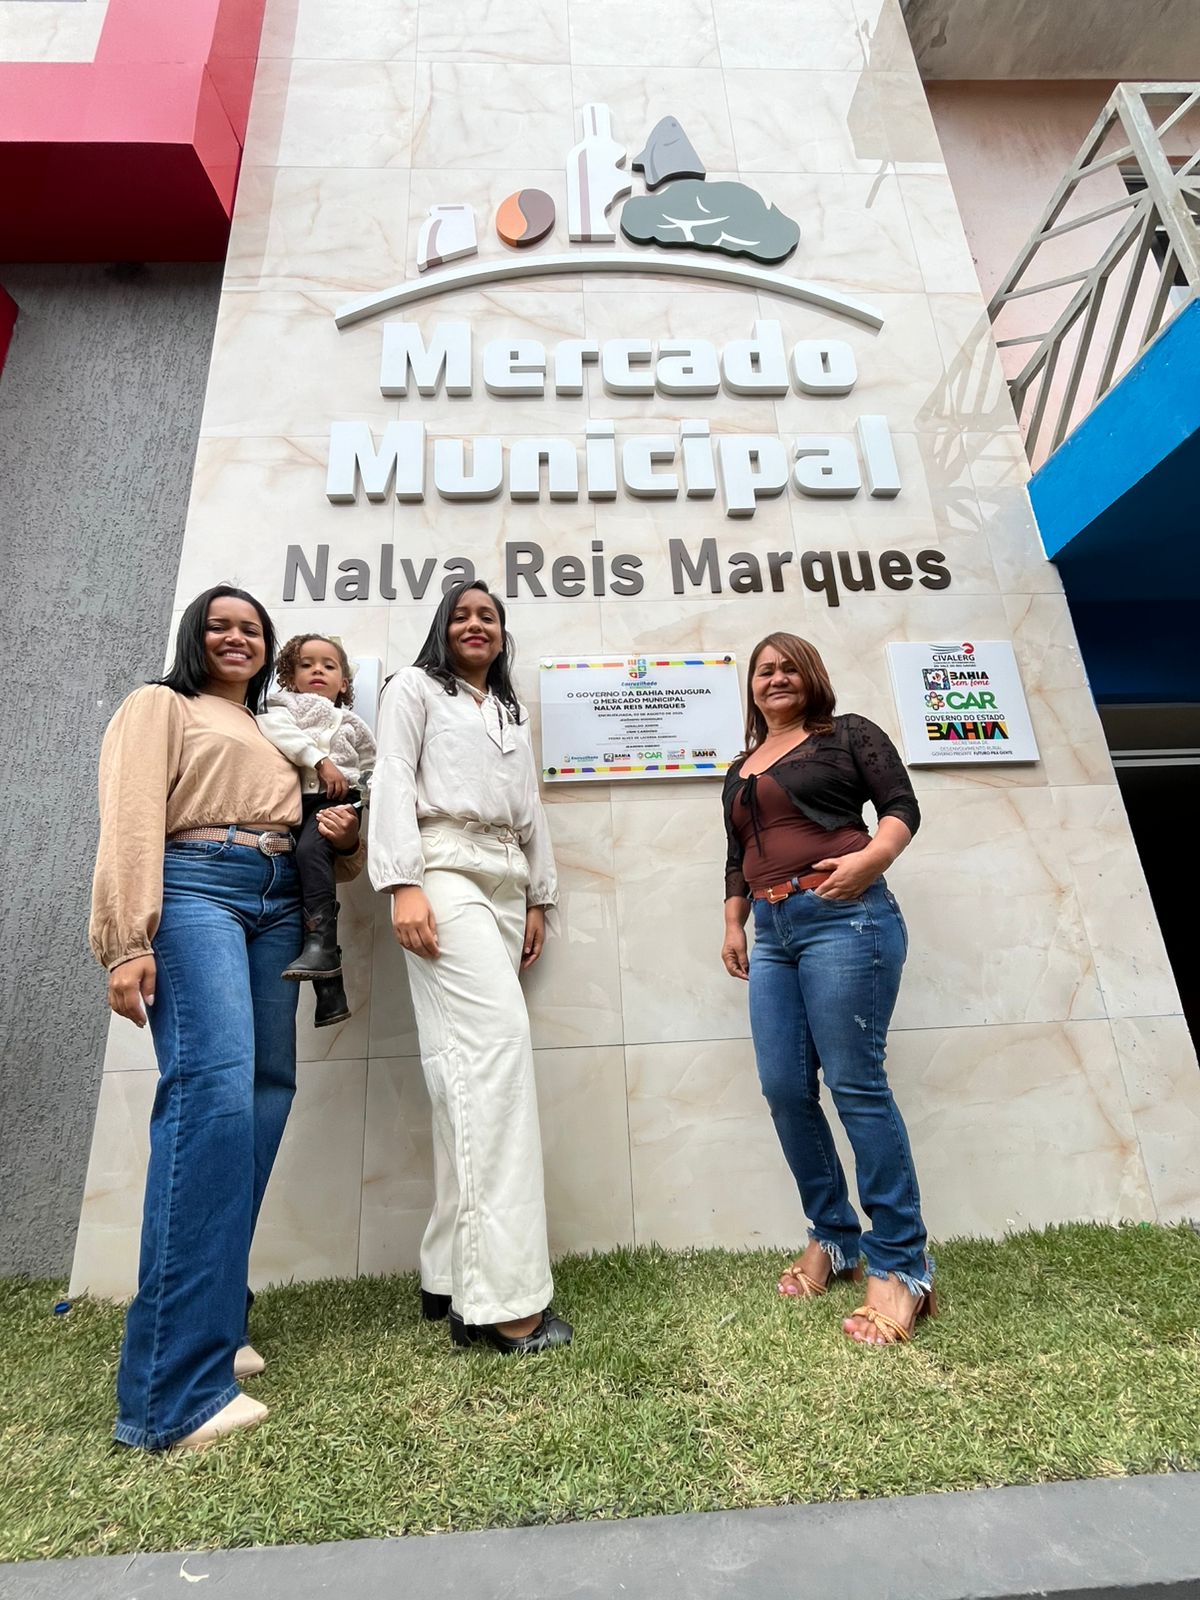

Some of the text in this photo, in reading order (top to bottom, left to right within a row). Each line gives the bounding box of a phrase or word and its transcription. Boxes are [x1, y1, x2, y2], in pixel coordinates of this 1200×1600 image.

[380, 319, 858, 397] Mercado
[326, 415, 901, 517] Municipal
[505, 540, 644, 597] Reis
[669, 538, 951, 607] Marques
[932, 654, 975, 662] CIVALERG
[949, 671, 989, 680] BAHIA
[970, 679, 990, 687] fome
[636, 689, 664, 697] BAHIA
[665, 688, 711, 696] INAUGURA
[946, 691, 998, 710] CAR
[925, 714, 962, 722] GOVERNO
[976, 713, 1005, 721] ESTADO
[926, 721, 1009, 740] BAHIA
[644, 751, 662, 759] CAR
